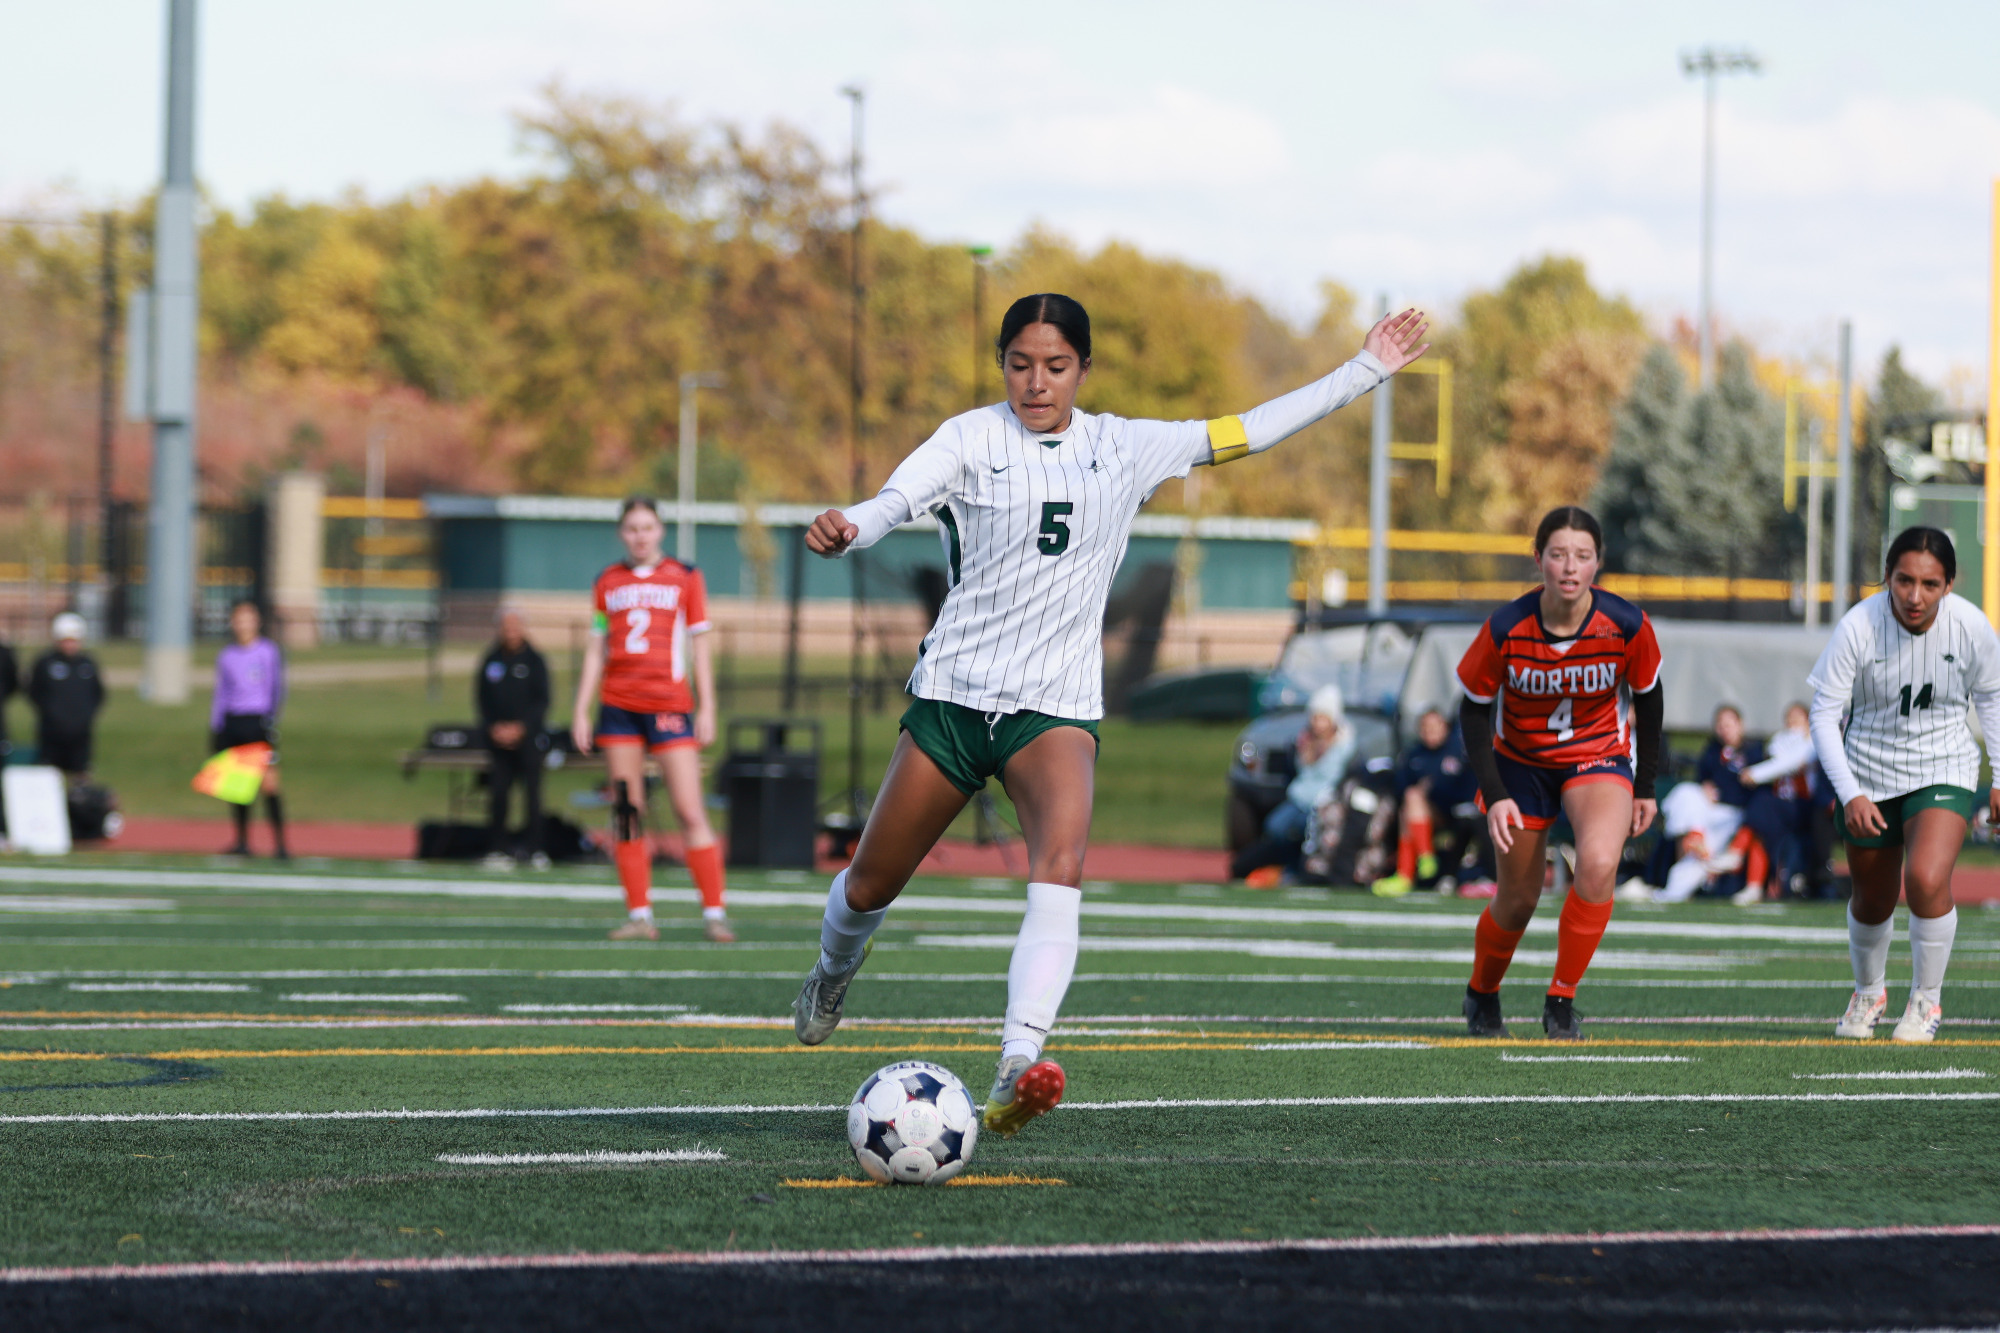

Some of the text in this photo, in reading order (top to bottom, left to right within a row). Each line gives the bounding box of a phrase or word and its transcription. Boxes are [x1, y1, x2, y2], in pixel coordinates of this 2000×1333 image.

[1037, 502, 1073, 556] 5
[625, 608, 651, 654] 2
[1507, 662, 1617, 695] MORTON
[1900, 683, 1932, 717] 14
[1547, 697, 1574, 742] 4
